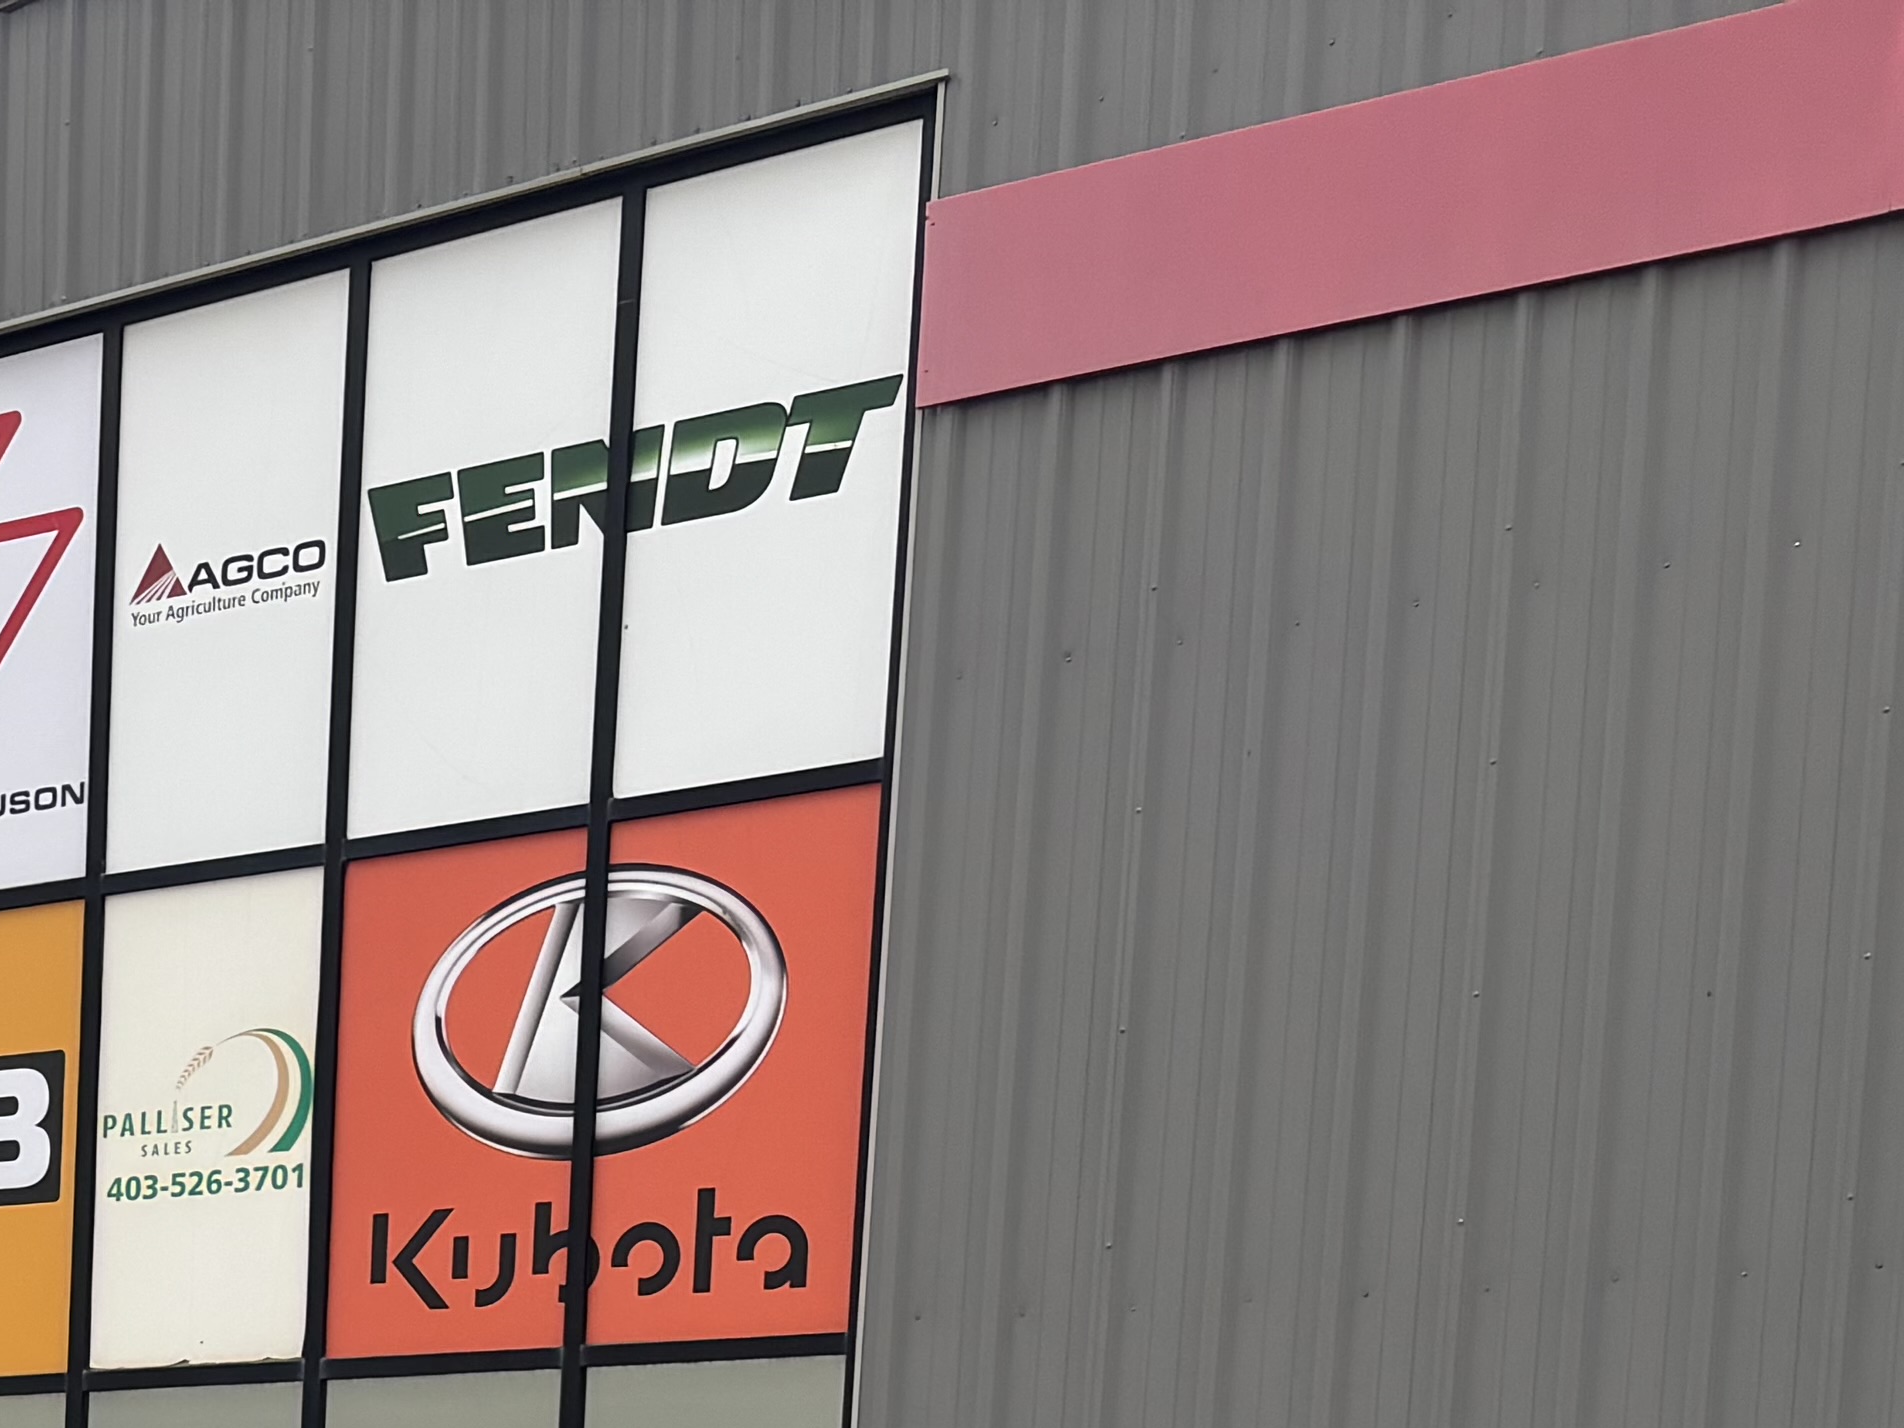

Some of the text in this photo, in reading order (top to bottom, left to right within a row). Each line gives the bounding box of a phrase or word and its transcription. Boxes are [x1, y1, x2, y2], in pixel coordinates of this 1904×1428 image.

[367, 374, 903, 582] FENDT
[187, 539, 326, 593] AGCO
[131, 581, 320, 627] Your Agriculture Company
[140, 1139, 193, 1158] SALES
[106, 1163, 304, 1203] 403-526-3701
[370, 1188, 810, 1310] Kubota
